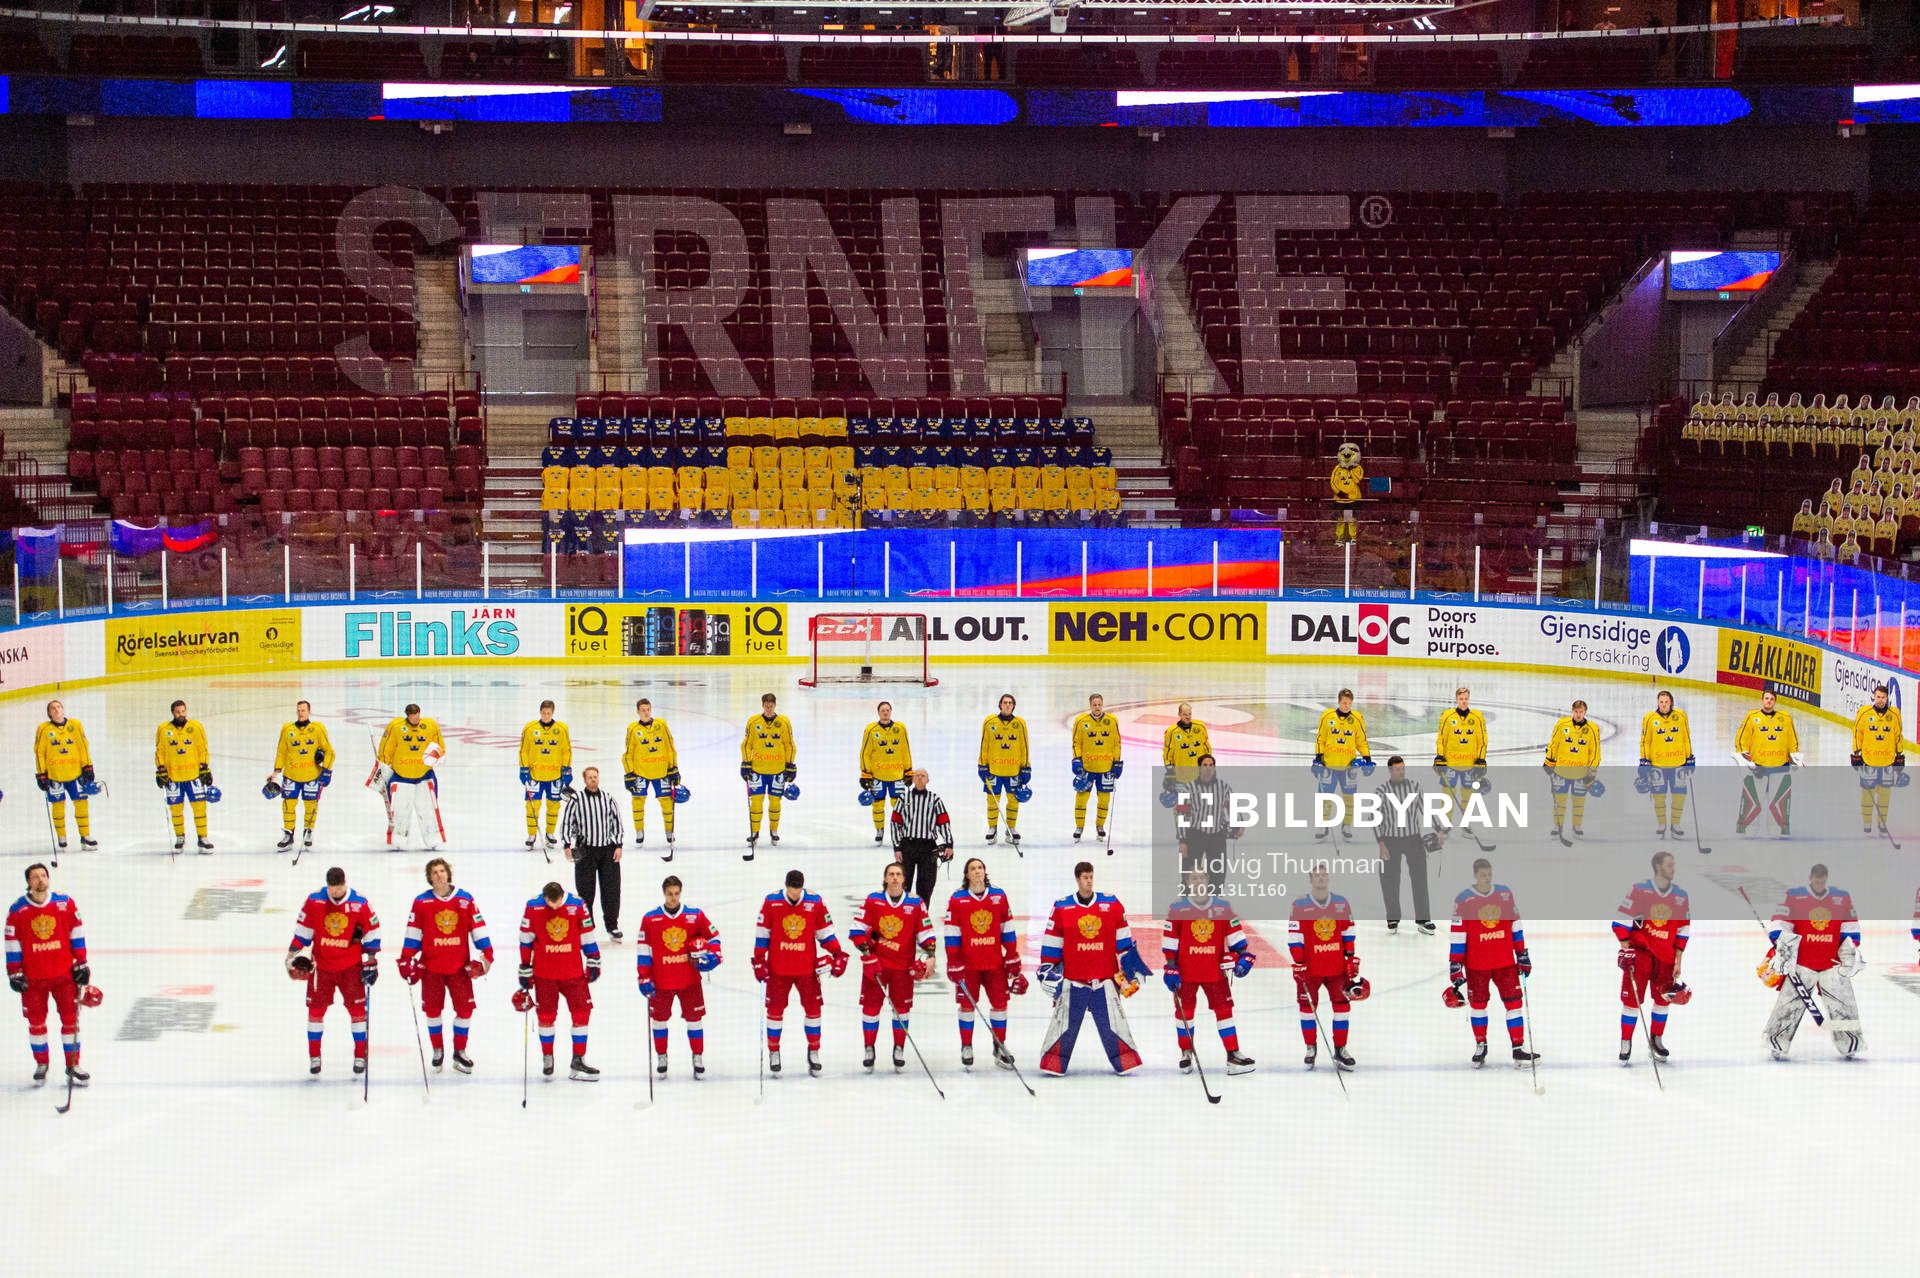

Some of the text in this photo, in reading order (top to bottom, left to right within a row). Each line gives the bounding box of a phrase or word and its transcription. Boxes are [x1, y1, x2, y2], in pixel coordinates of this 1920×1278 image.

[334, 185, 1358, 402] SERNEKE
[472, 605, 515, 619] JÄRN
[570, 606, 608, 636] iQ
[745, 606, 783, 636] iQ
[1428, 607, 1477, 624] Doors
[345, 610, 520, 658] Flinks
[888, 616, 1029, 641] ALL OUT.
[1291, 613, 1410, 645] DALOC
[1428, 624, 1464, 639] with
[1539, 615, 1651, 650] Gjensidige
[117, 630, 240, 656] Rörelsekurvan
[155, 649, 178, 658] Svenska
[259, 641, 294, 650] Gjensidige
[571, 638, 608, 653] fuel
[745, 638, 782, 653] fuel
[1427, 641, 1500, 657] purpose.
[1570, 644, 1650, 671] Försäkring
[1729, 636, 1817, 690] BLÅKLÄDER
[1773, 682, 1810, 701] WORKWEAR
